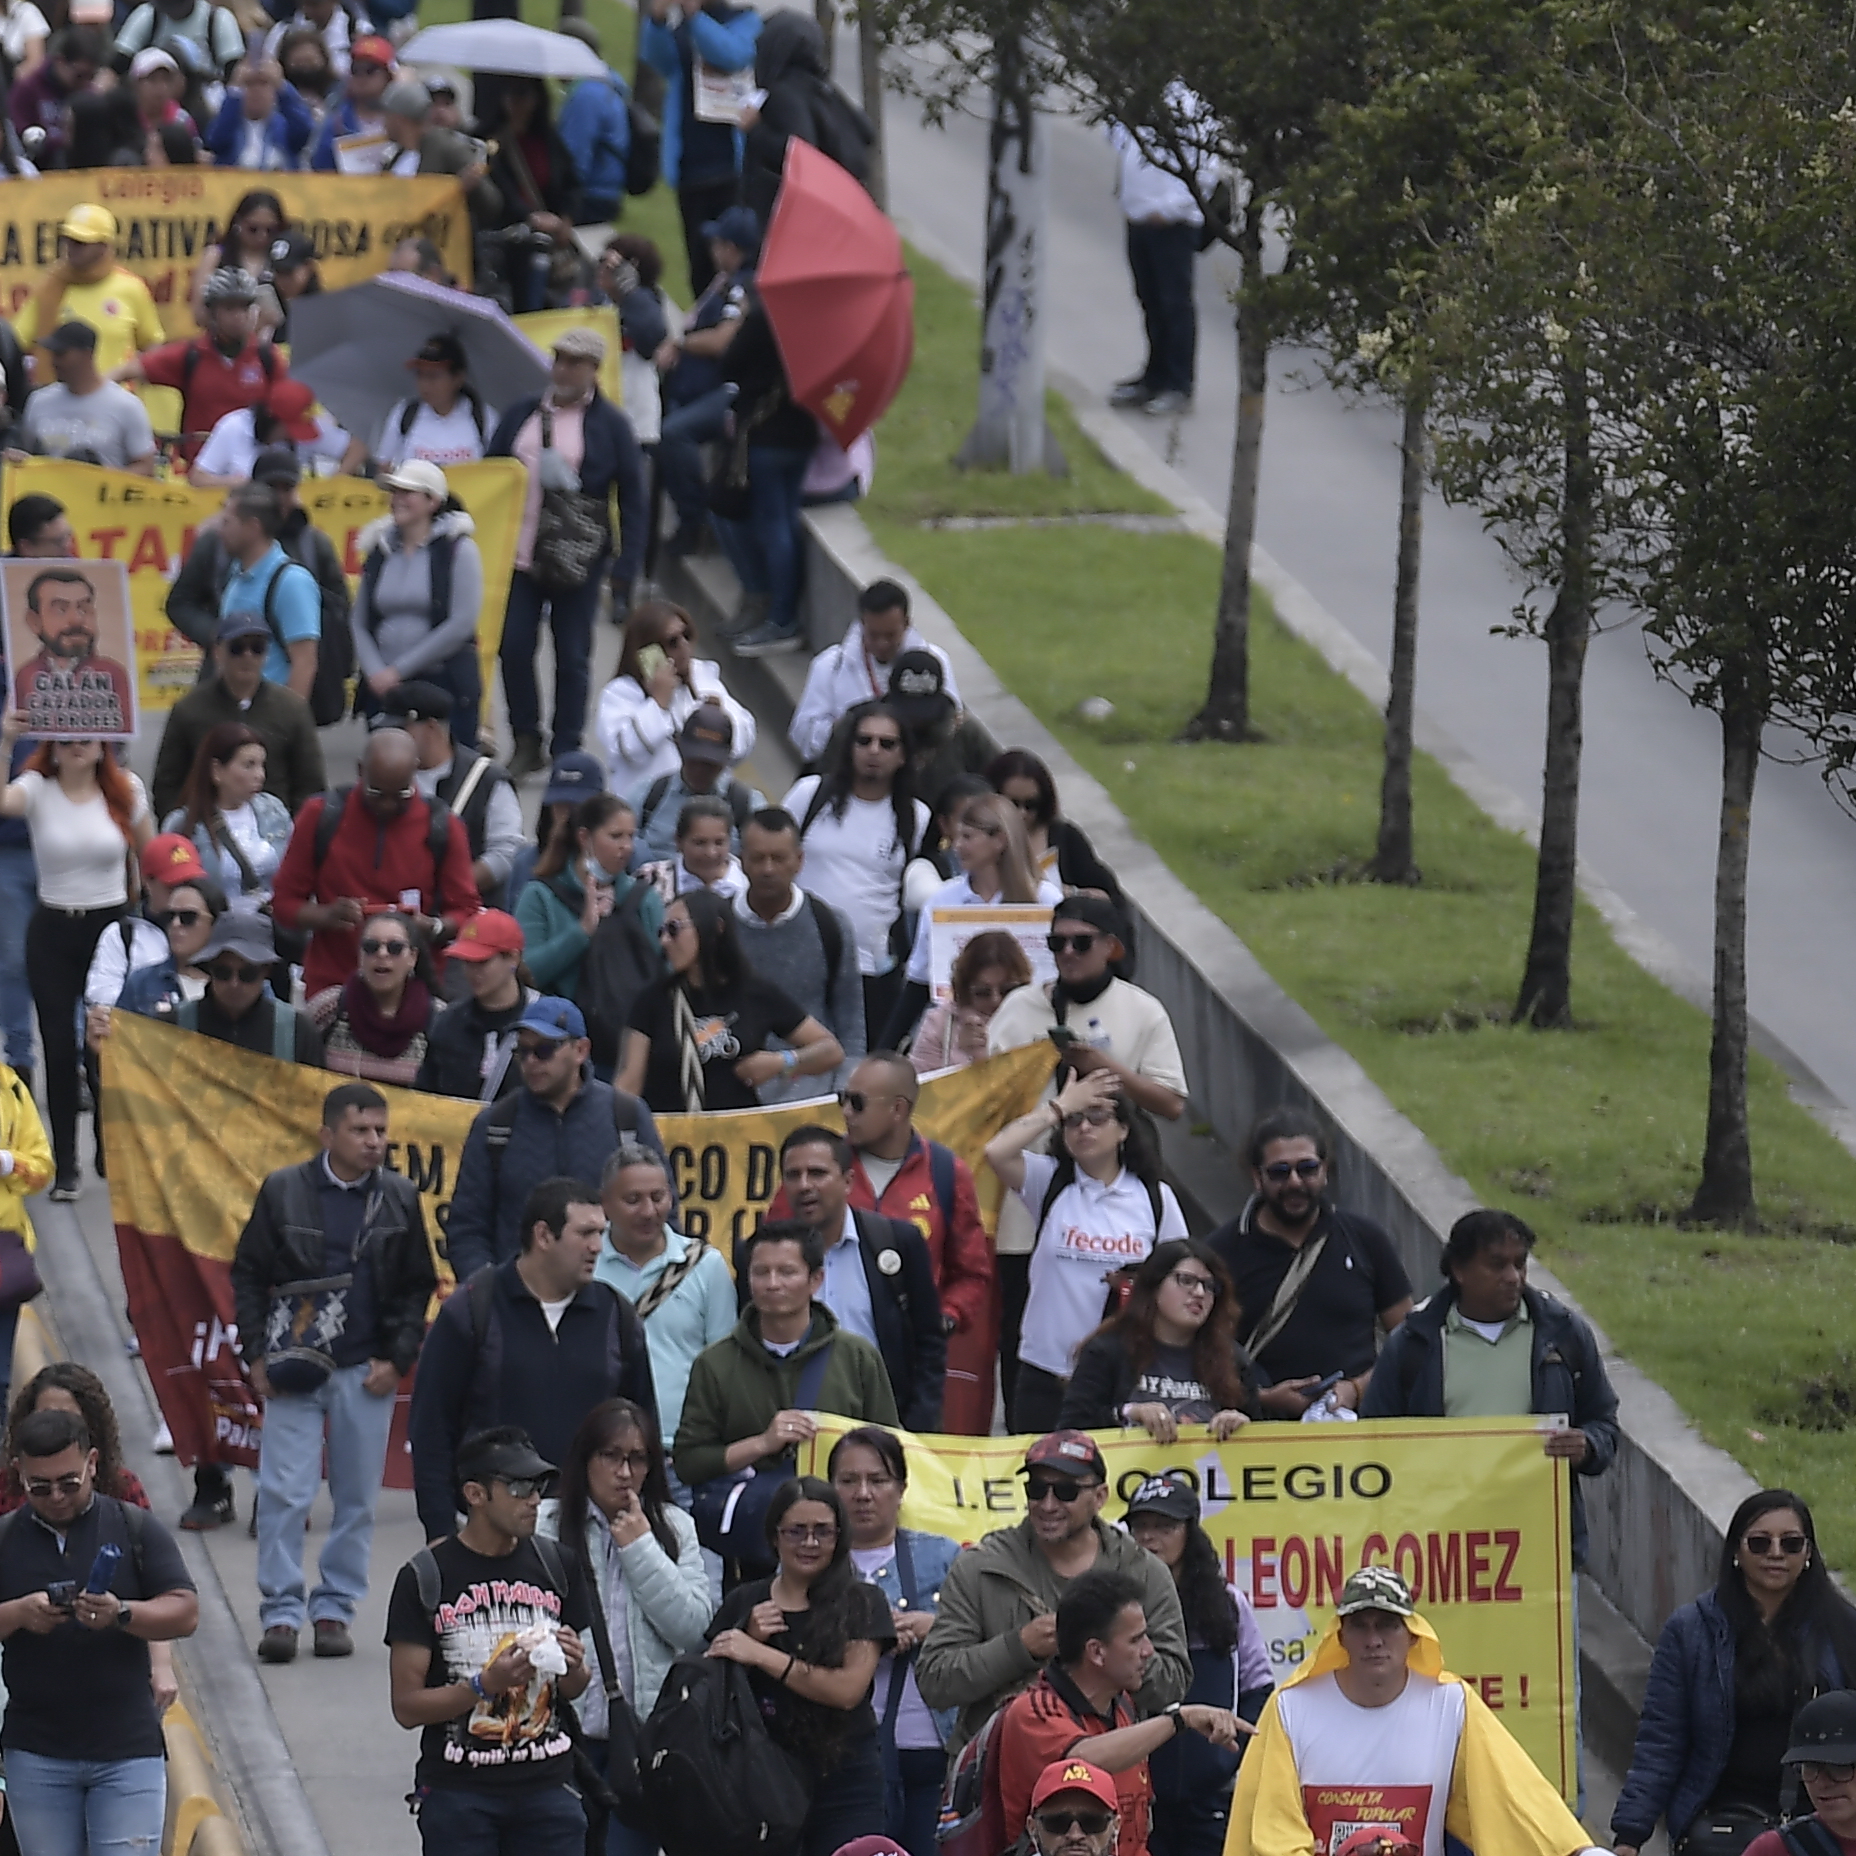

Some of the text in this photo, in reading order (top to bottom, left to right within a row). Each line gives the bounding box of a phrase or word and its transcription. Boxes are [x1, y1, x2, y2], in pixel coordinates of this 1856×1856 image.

[434, 1582, 488, 1634] IRON
[1317, 1791, 1383, 1806] CONSULTA
[1355, 1806, 1416, 1821] POPULAR
